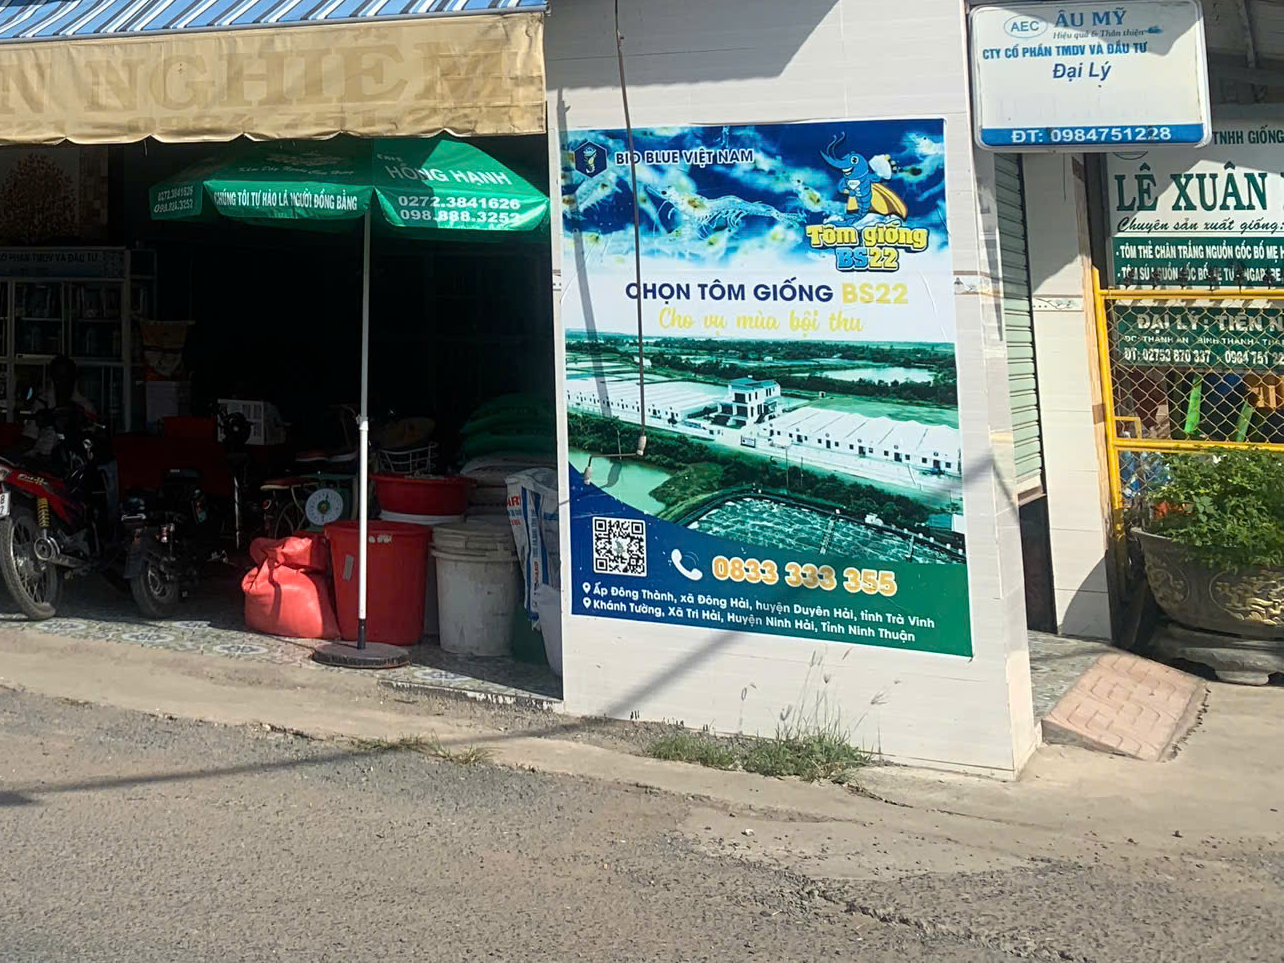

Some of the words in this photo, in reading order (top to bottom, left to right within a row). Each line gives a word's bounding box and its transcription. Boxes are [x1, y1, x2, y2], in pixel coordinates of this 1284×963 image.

[1010, 20, 1040, 33] AEC
[1055, 9, 1084, 27] ÂU
[1092, 7, 1127, 26] MỸ
[982, 49, 1001, 59] CTY
[1055, 45, 1085, 56] TMDV
[1090, 40, 1103, 55] VÀ
[1133, 40, 1148, 53] TƯ
[1052, 62, 1082, 82] Đại
[1089, 61, 1112, 82] Lý
[1011, 128, 1043, 143] ĐT:
[1050, 126, 1172, 143] 0984751228
[1212, 130, 1244, 145] TNHH
[1248, 125, 1284, 144] GIỐNG
[616, 151, 643, 165] BIO
[645, 150, 682, 164] BLUE
[685, 148, 715, 168] VIỆT
[717, 148, 755, 164] NAM
[450, 169, 512, 186] HẠNH
[1115, 162, 1159, 212] LÊ
[1170, 160, 1267, 211] XUÂN
[398, 196, 521, 210] 0272.3841626
[805, 223, 859, 247] Tôm
[862, 219, 929, 250] giống
[1117, 216, 1169, 234] Chuyên
[1174, 216, 1198, 231] sản
[1203, 216, 1234, 231] xuất
[1240, 216, 1283, 234] giống:
[836, 246, 899, 270] BS22
[1120, 242, 1137, 258] TÔM
[1138, 240, 1153, 258] THẺ
[1155, 242, 1176, 258] CHÂN
[1177, 240, 1204, 259] TRẮNG
[1206, 240, 1233, 259] NGUỒN
[1235, 240, 1252, 259] GỐC
[1253, 240, 1265, 259] BỐ
[1266, 245, 1279, 263] MẸ
[625, 281, 691, 307] CHỌN
[697, 280, 746, 302] TÔM
[753, 276, 834, 303] GIỐNG
[841, 283, 909, 305] BS22
[659, 307, 695, 330] Cho
[703, 314, 729, 336] vụ
[736, 309, 780, 331] mùa
[788, 307, 821, 338] bội
[828, 310, 865, 333] thu
[712, 555, 780, 585] 0833
[784, 561, 837, 590] 333
[843, 567, 898, 597] 355
[593, 582, 608, 596] Ấp
[610, 586, 639, 600] Đông
[641, 589, 678, 604] Thành,
[680, 593, 695, 604] xã
[697, 593, 727, 609] Đông
[730, 595, 753, 611] Hải,
[755, 600, 790, 616] huyện
[793, 603, 830, 618] Duyên
[833, 606, 857, 621] Hải,
[860, 609, 883, 623] tỉnh
[886, 612, 905, 625] Trà
[908, 615, 936, 629] Vinh
[593, 599, 627, 612] Khánh
[629, 602, 666, 617] Tường,
[668, 605, 684, 618] Xã
[702, 609, 725, 624] Hải,
[727, 612, 762, 627] Huyện
[765, 617, 791, 629] Ninh
[794, 618, 818, 633] Hải,
[821, 620, 845, 634] Tỉnh
[848, 624, 876, 637] Ninh
[878, 628, 916, 643] Thuận
